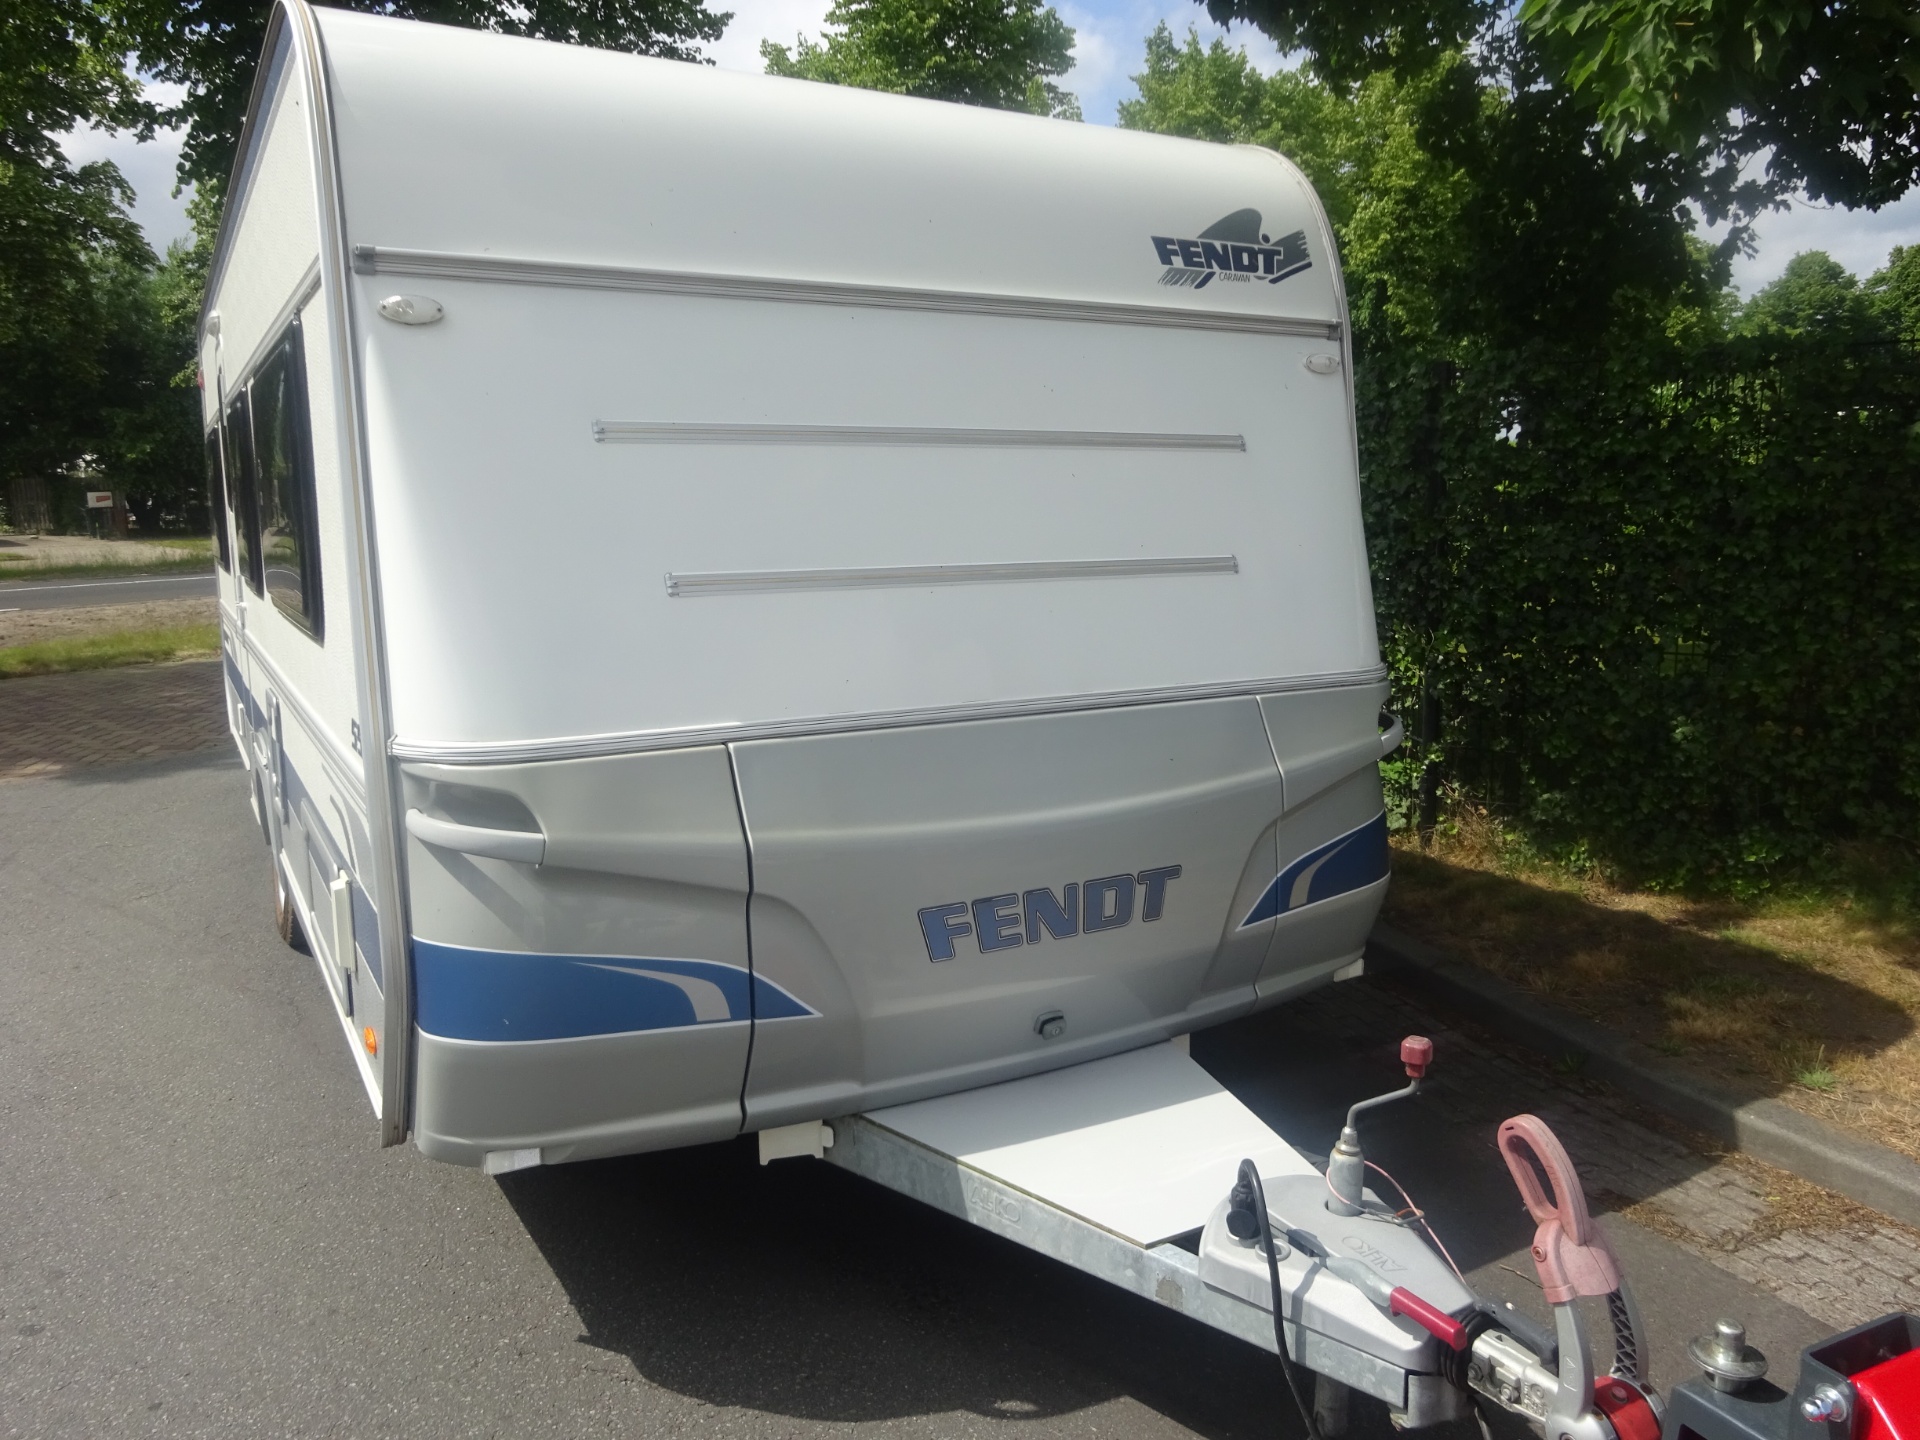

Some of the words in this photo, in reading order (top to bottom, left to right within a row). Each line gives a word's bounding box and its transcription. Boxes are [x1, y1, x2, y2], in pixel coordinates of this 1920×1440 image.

[1150, 235, 1282, 275] FENDT
[1218, 271, 1251, 283] CARAVAN
[917, 864, 1183, 963] FENDT
